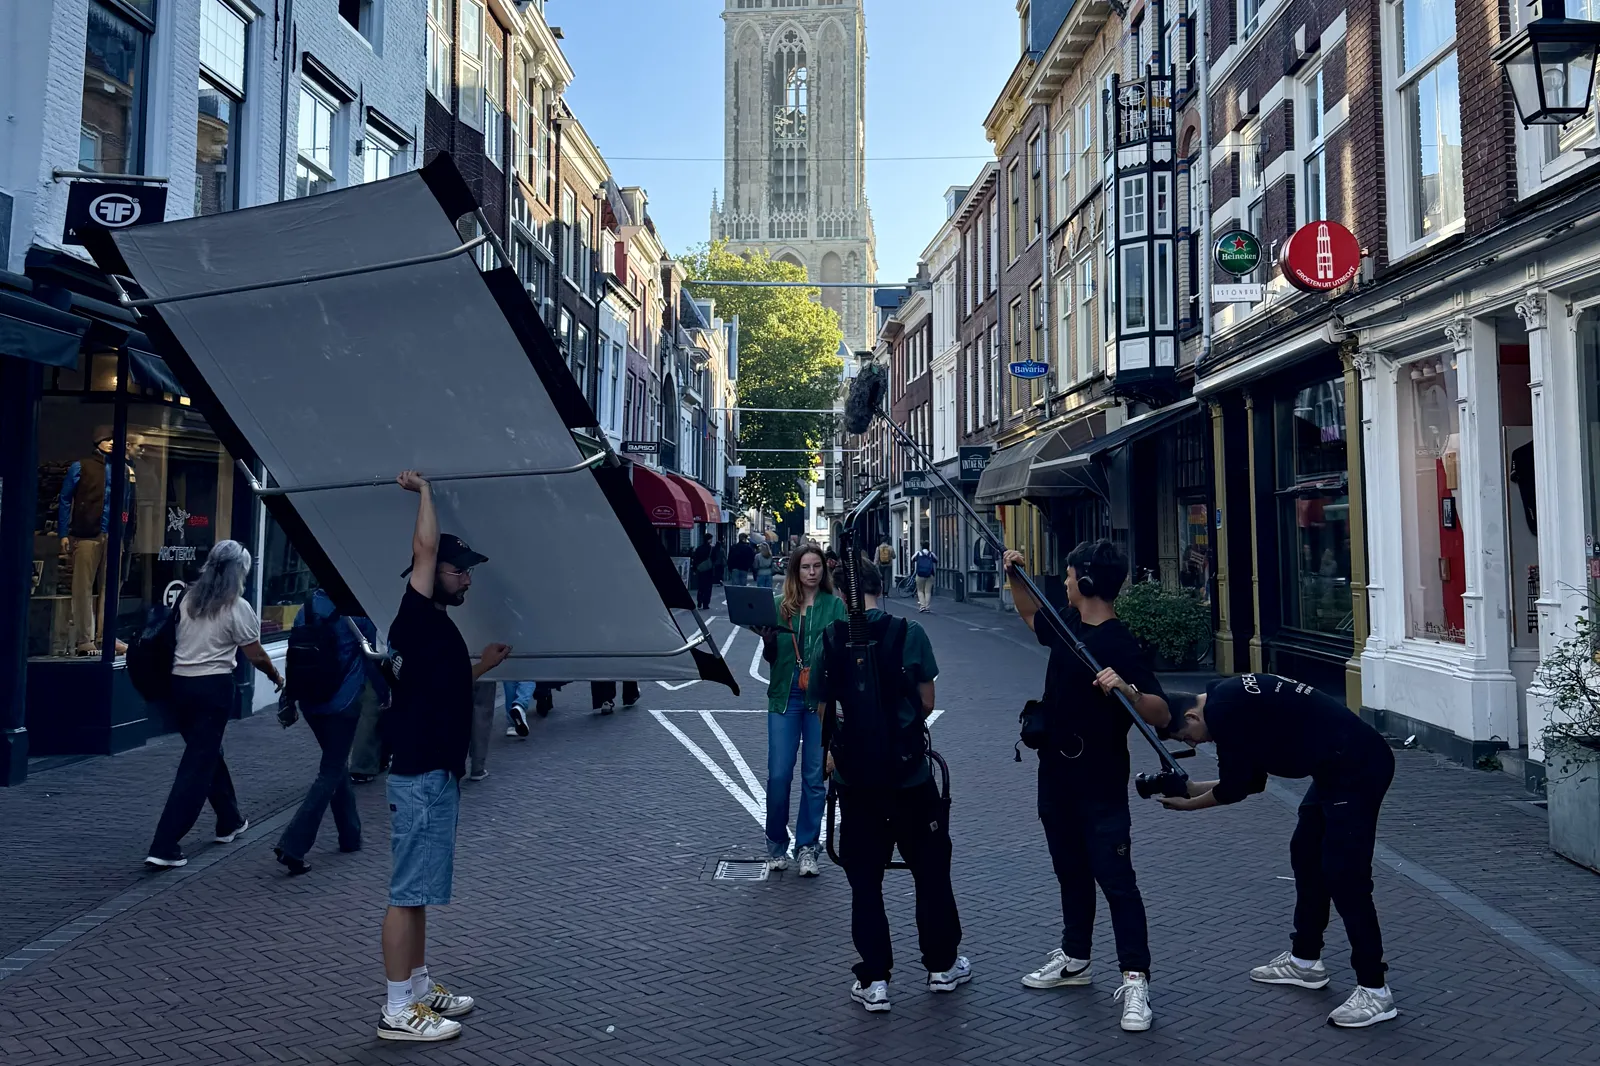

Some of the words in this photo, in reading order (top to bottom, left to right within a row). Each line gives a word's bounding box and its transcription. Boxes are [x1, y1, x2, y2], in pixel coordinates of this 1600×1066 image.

[1221, 252, 1257, 260] Heineken
[1296, 268, 1322, 287] GROETEN
[1332, 265, 1356, 286] UTRECHT
[1014, 365, 1045, 374] Bavaria
